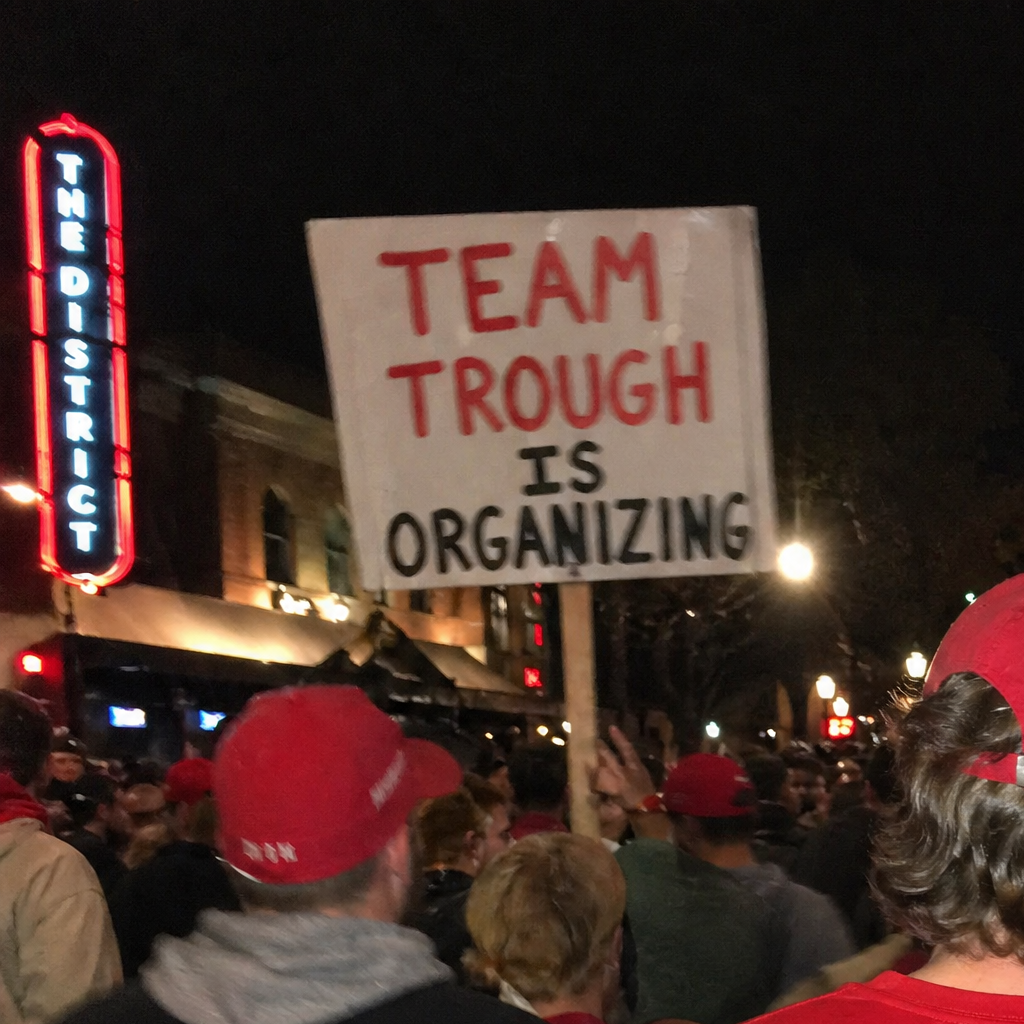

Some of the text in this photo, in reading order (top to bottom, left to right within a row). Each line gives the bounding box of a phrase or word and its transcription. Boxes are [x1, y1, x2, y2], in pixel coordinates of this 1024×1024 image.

[379, 232, 660, 337] TEAM
[55, 152, 98, 553] THE DISTRICT
[387, 340, 712, 438] TROUGH
[518, 440, 606, 497] IS
[387, 492, 752, 578] ORGANIZING
